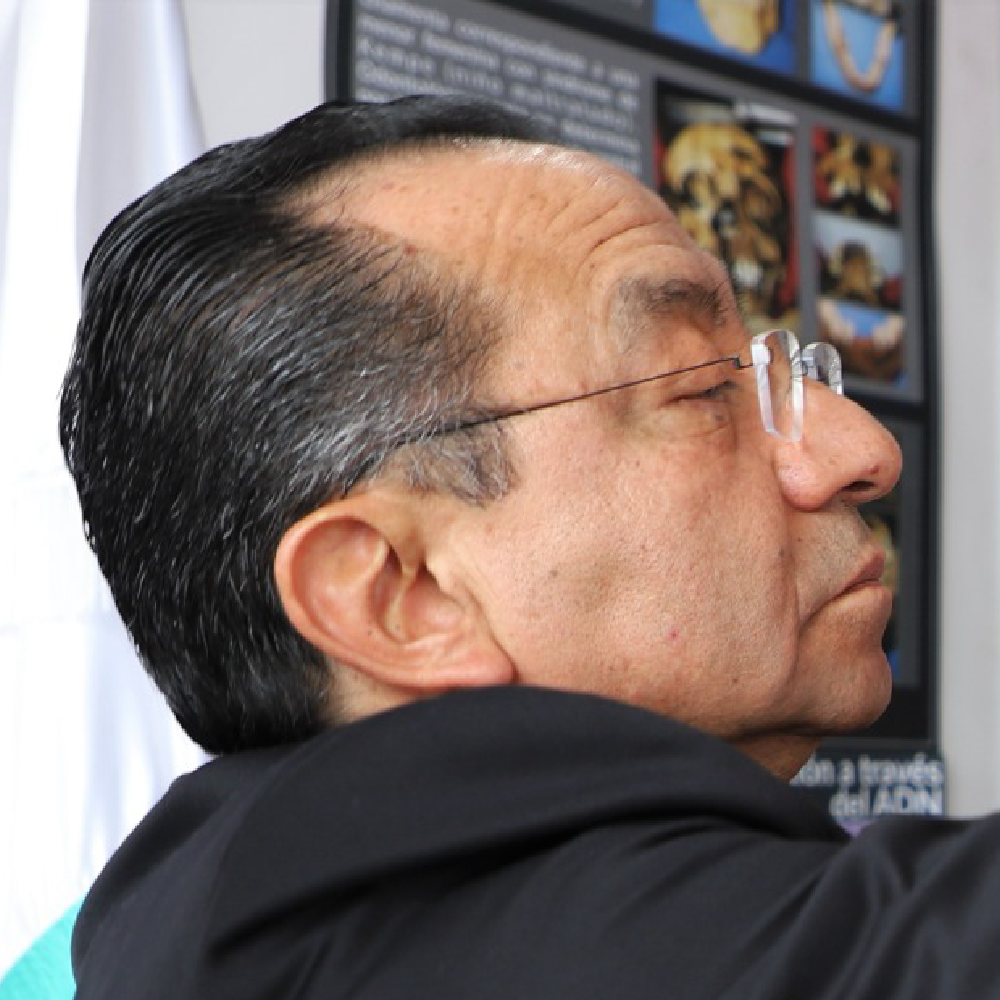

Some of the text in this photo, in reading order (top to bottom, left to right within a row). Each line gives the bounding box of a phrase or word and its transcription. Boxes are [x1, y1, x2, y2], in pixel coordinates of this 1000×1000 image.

[840, 759, 855, 787] a
[858, 752, 943, 787] través
[829, 786, 943, 817] del ADN
